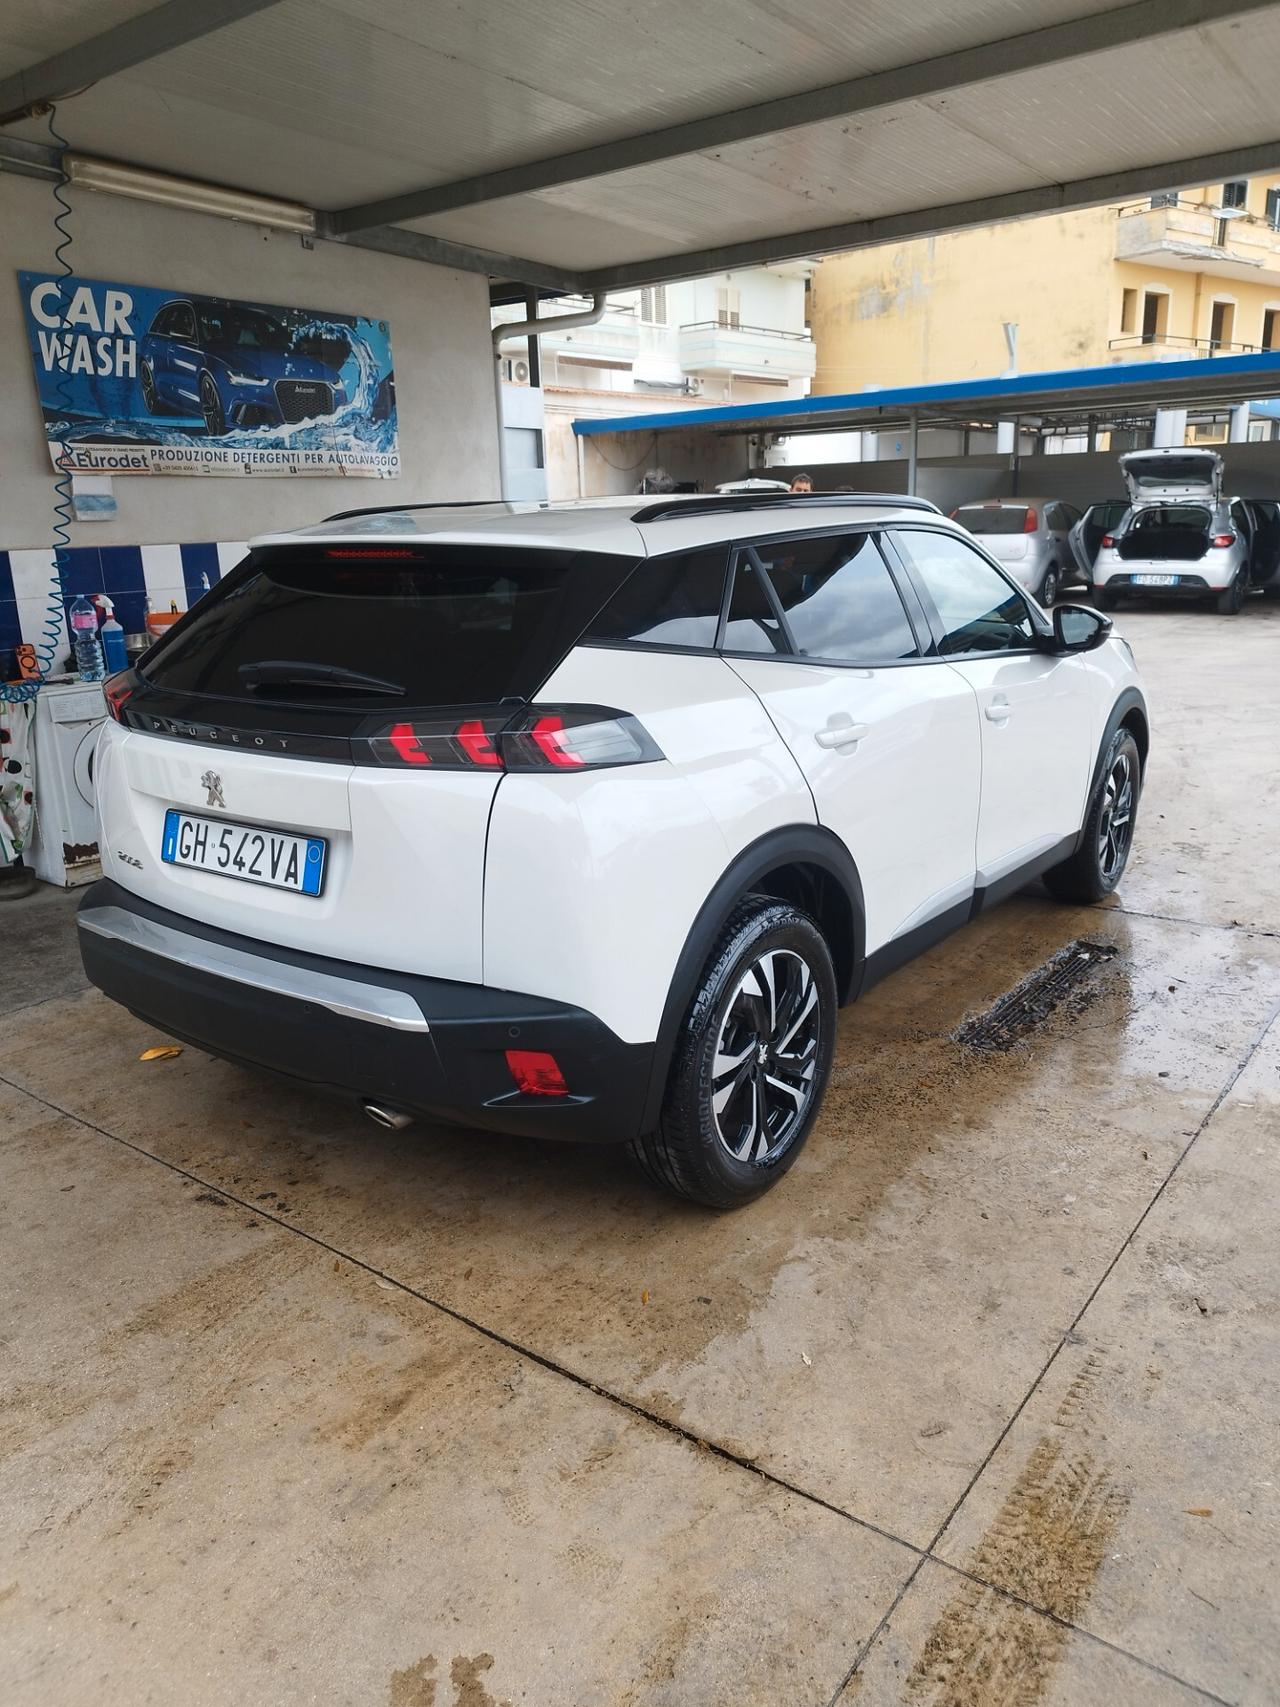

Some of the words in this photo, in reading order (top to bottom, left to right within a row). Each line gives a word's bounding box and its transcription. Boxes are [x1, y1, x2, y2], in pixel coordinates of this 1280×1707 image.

[30, 281, 134, 336] CAR
[37, 330, 137, 378] WASH
[76, 453, 149, 468] Eurodet
[150, 449, 229, 463] PRODUZIONE
[233, 452, 301, 464] DETERGENTI
[304, 454, 324, 464] PER
[328, 454, 399, 466] AUTOLAVAGGIO
[153, 721, 288, 748] PEUGEOT
[179, 821, 209, 863] GH
[217, 828, 299, 885] 542VA
